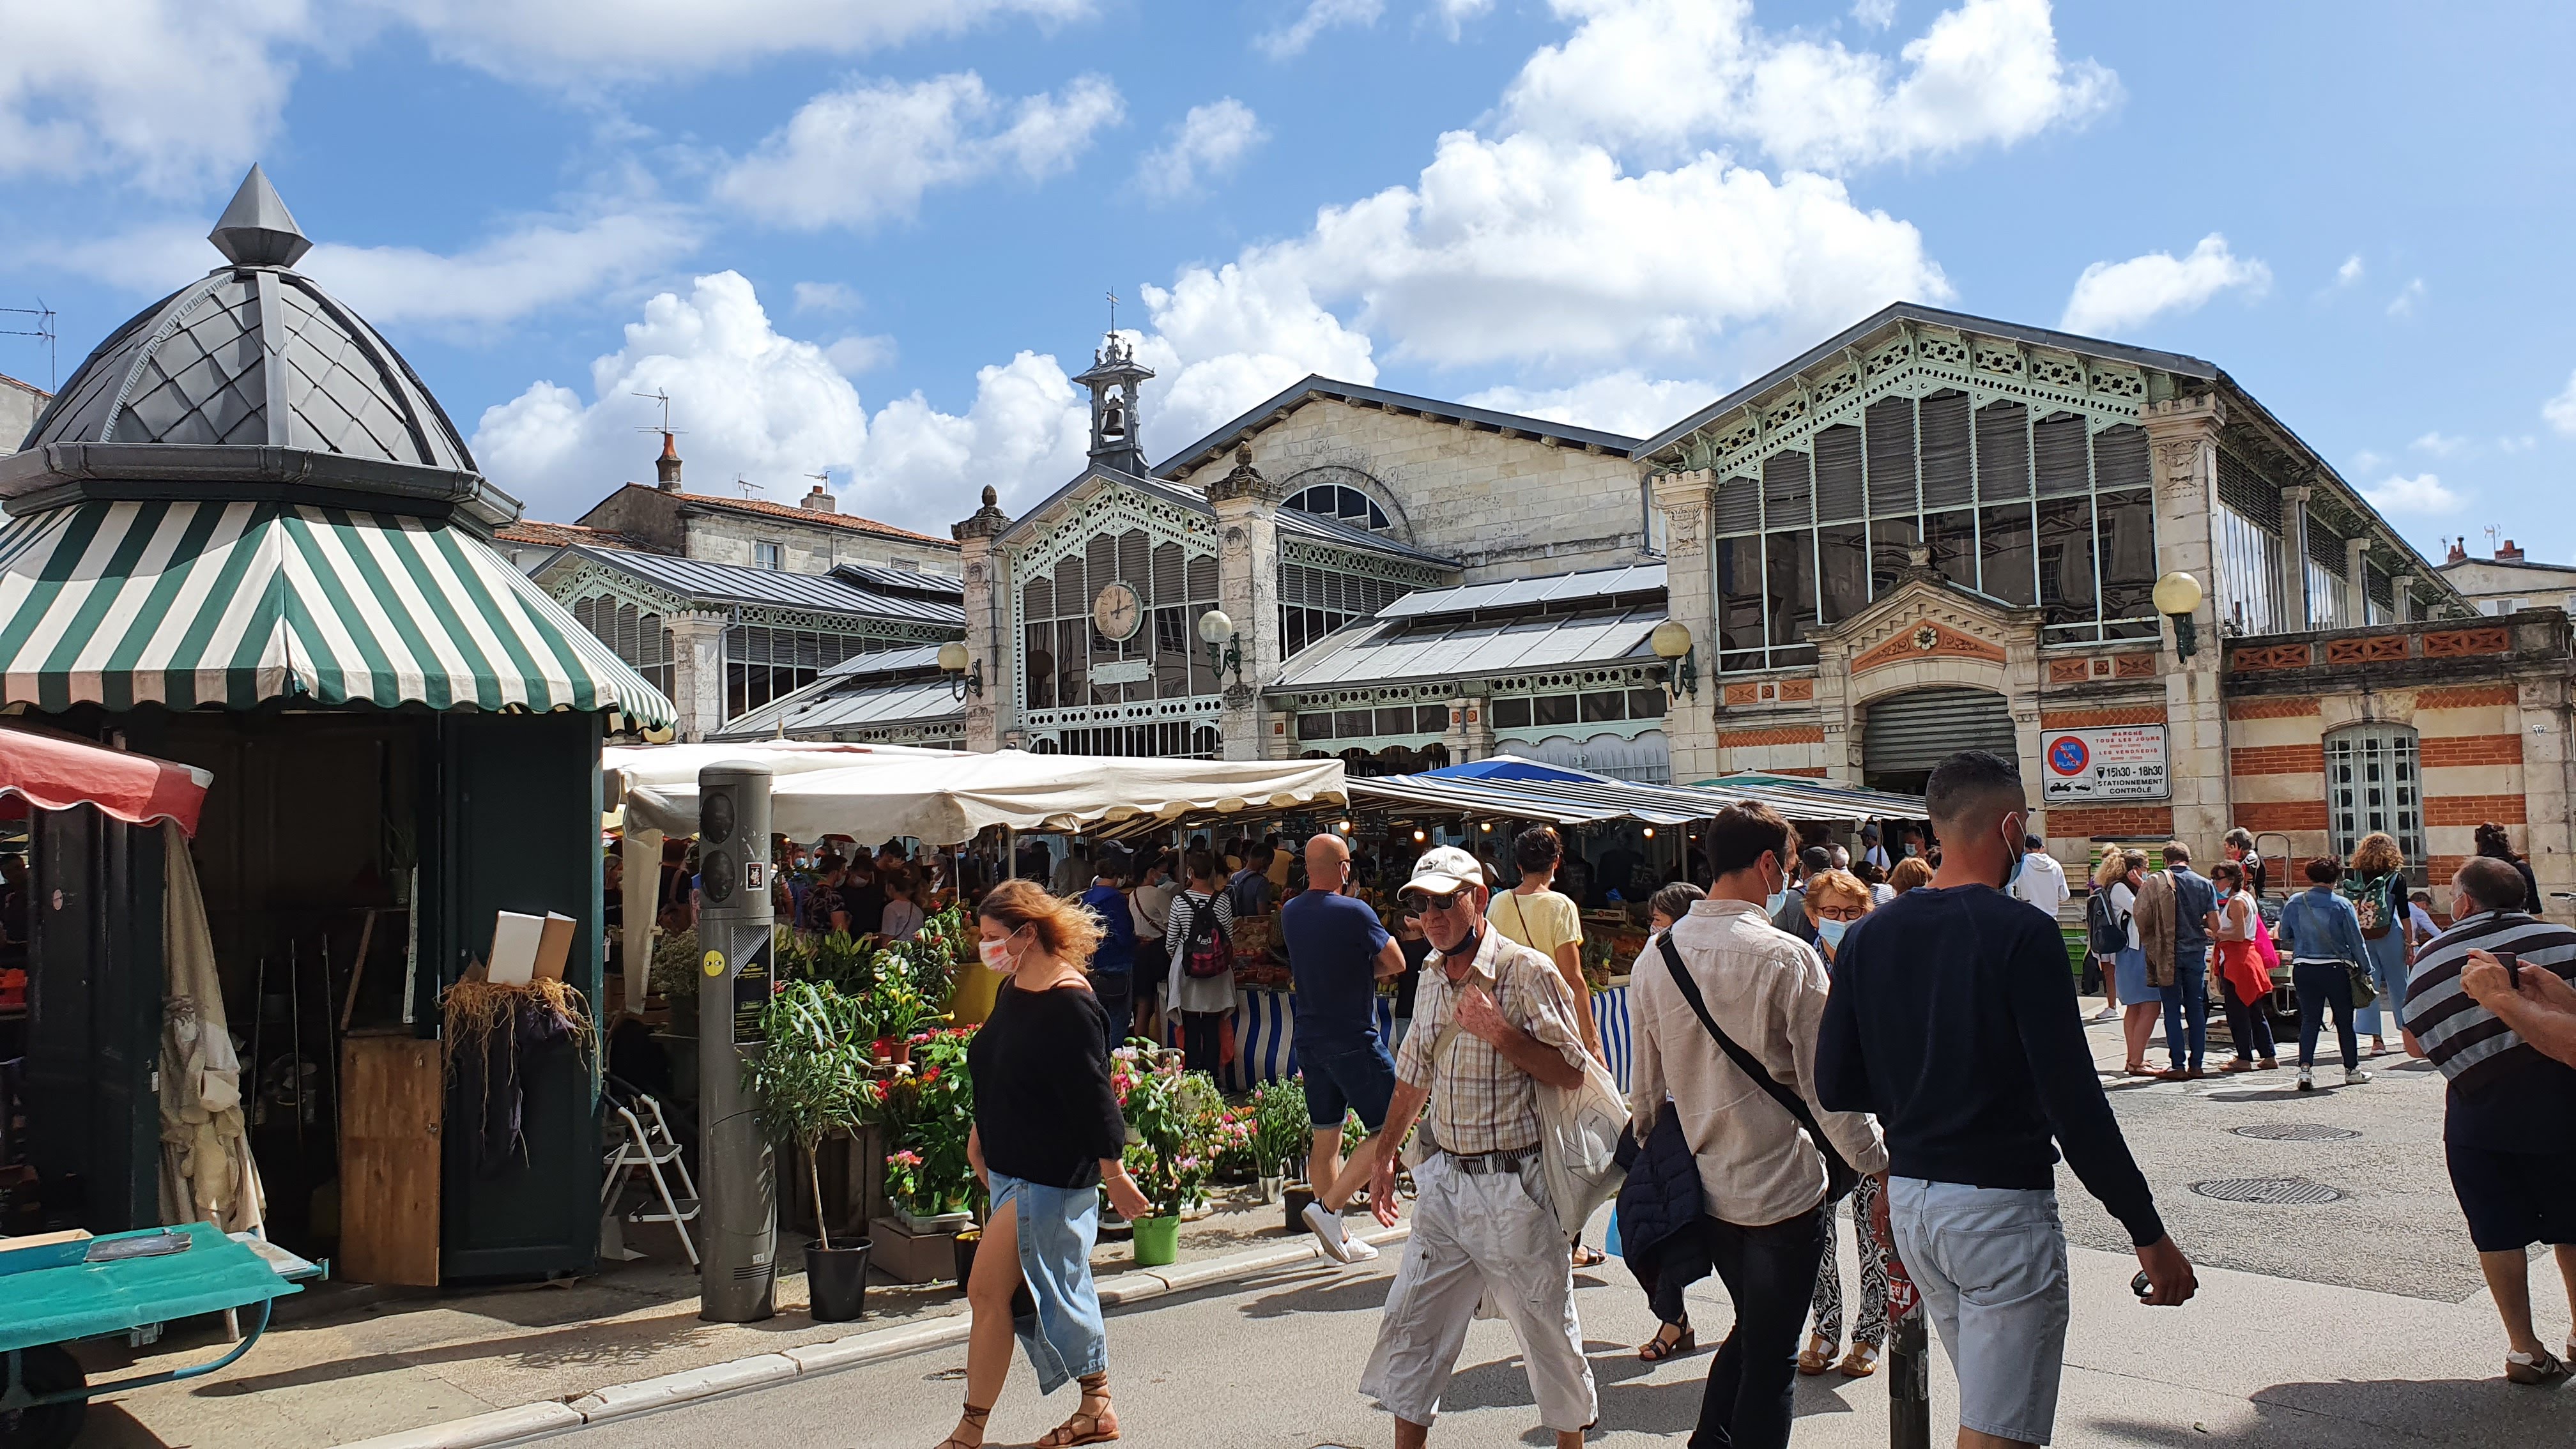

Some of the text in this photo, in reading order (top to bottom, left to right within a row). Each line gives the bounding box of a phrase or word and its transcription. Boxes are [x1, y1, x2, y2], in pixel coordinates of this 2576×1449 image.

[2106, 767, 2131, 777] 15h30
[2138, 765, 2163, 776] 18h30
[2097, 778, 2163, 786] STATIONNEMENT
